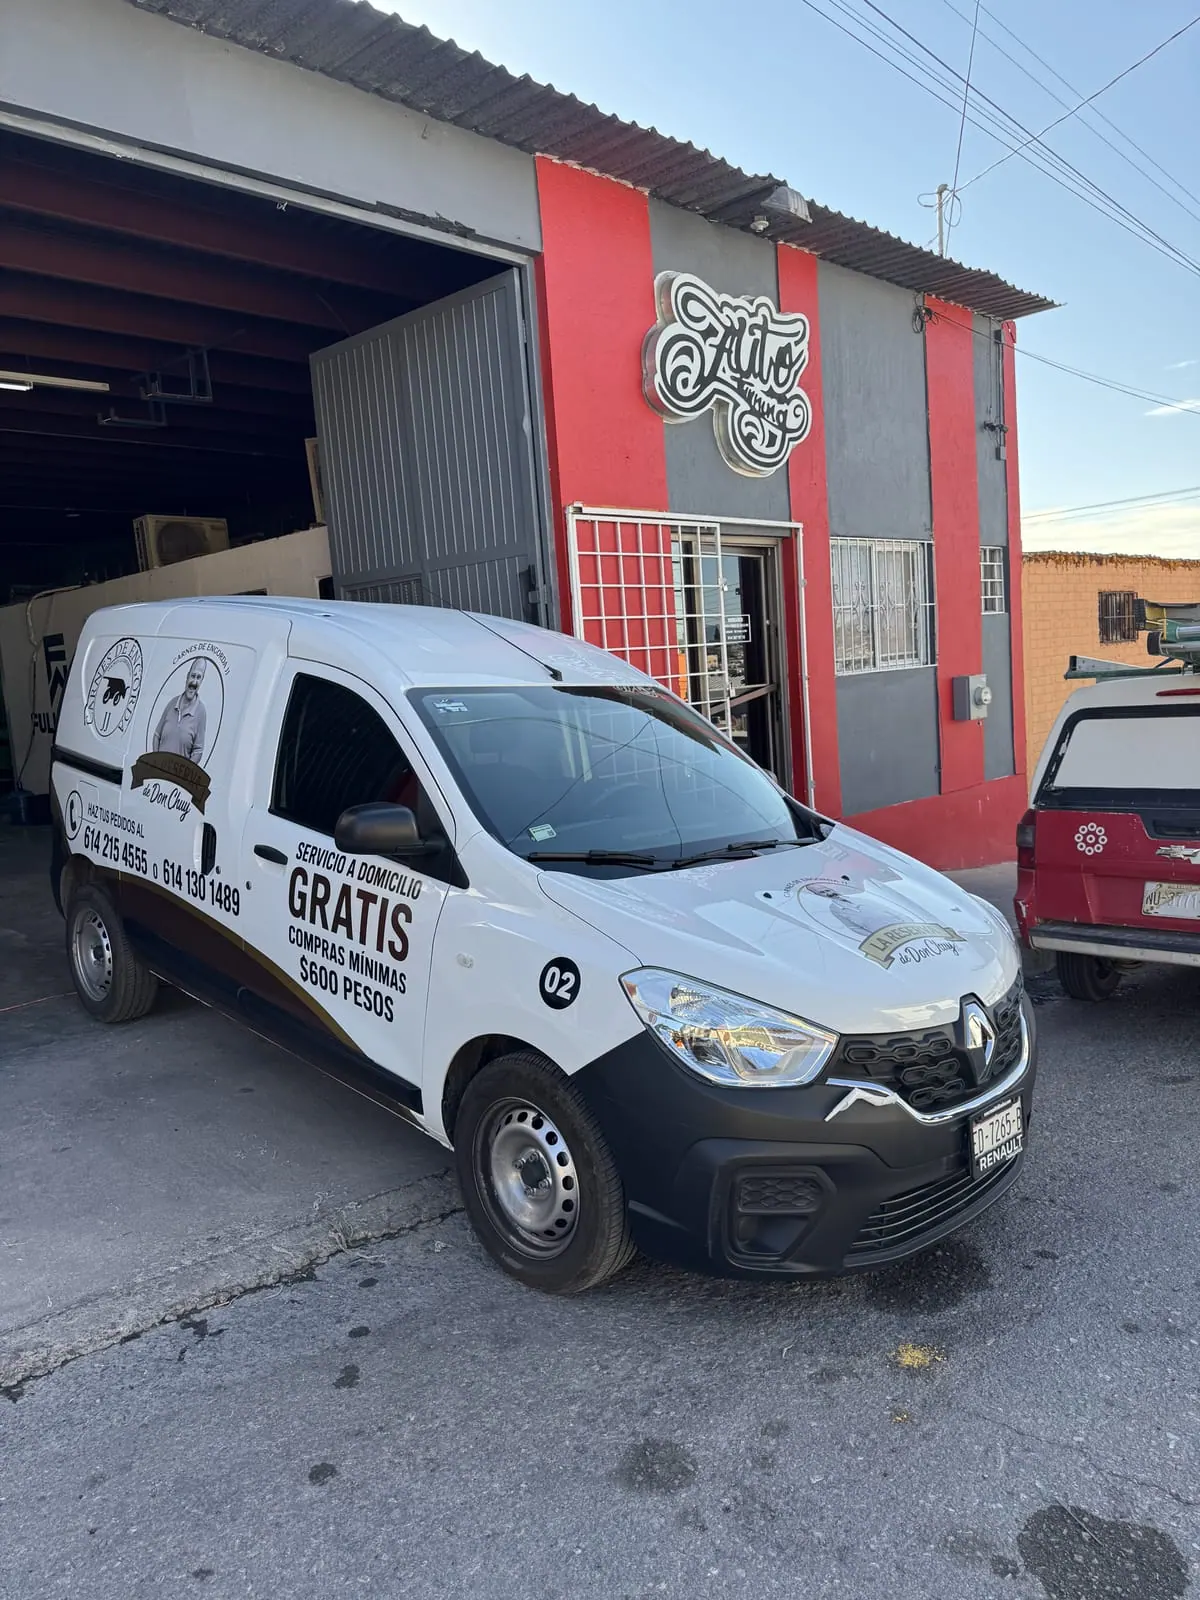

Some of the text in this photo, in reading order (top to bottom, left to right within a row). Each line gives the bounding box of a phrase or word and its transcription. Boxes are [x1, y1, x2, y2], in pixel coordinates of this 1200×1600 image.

[115, 641, 129, 657] DE
[172, 643, 198, 665] CARNES
[198, 642, 207, 651] DE
[206, 643, 228, 669] ENGORDA
[100, 711, 111, 732] JJ
[87, 803, 145, 839] HAZ TUS PEDIDOS AL
[142, 783, 191, 823] de Don Chuy
[84, 826, 100, 853] 614
[103, 833, 120, 862] 215
[121, 842, 148, 875] 4555
[163, 858, 182, 891] 614
[185, 869, 206, 901] 130
[209, 879, 240, 916] 1489
[296, 842, 423, 900] SERVICIO A DOMICILIO
[288, 866, 413, 962] GRATIS
[870, 925, 941, 952] LA RESERVA
[899, 939, 960, 965] de Don Chuy
[288, 925, 407, 994] COMPRAS MÍNIMAS
[300, 955, 394, 1023] $600 PESOS
[544, 966, 576, 1001] 02
[980, 1134, 1023, 1171] RENAULT
